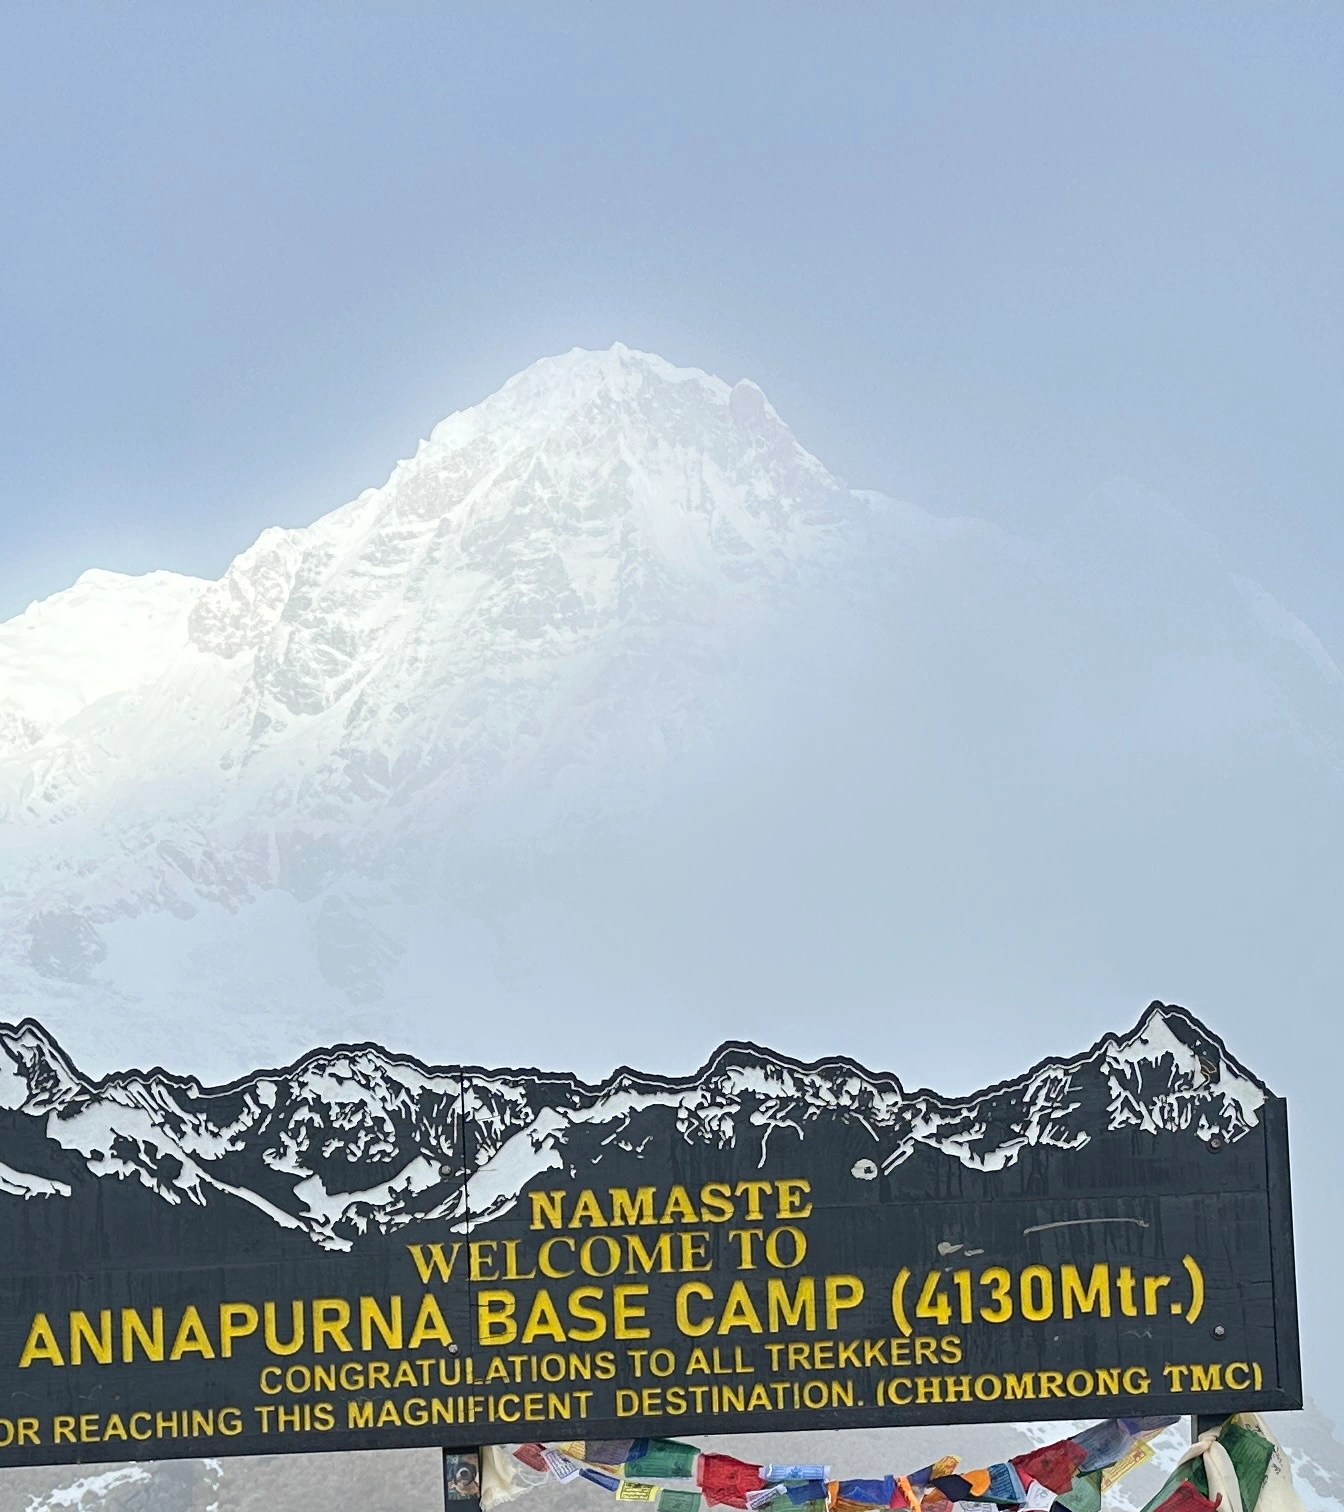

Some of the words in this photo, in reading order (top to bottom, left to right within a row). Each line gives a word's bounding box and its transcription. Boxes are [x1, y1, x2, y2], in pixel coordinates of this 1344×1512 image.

[529, 1178, 813, 1230] NAMASTE
[408, 1234, 712, 1281] WELCOME
[728, 1226, 809, 1269] TO
[18, 1294, 452, 1367] ANNAPURNA
[476, 1281, 653, 1347] BASE
[675, 1274, 866, 1336] CAMP
[890, 1254, 1206, 1338] (4130Mtr.)
[260, 1351, 616, 1392] CONGRATULATIONS
[630, 1347, 677, 1376] TO
[684, 1345, 756, 1376] ALL
[764, 1336, 963, 1370] TREKKERS
[53, 1408, 243, 1443] REACHING
[253, 1400, 337, 1434] THIS
[346, 1390, 594, 1427] MAGNIFICENT
[616, 1380, 863, 1415] DESTINATION.
[876, 1367, 1150, 1405] (CHHOMRONG
[1163, 1361, 1264, 1394] TMC)
